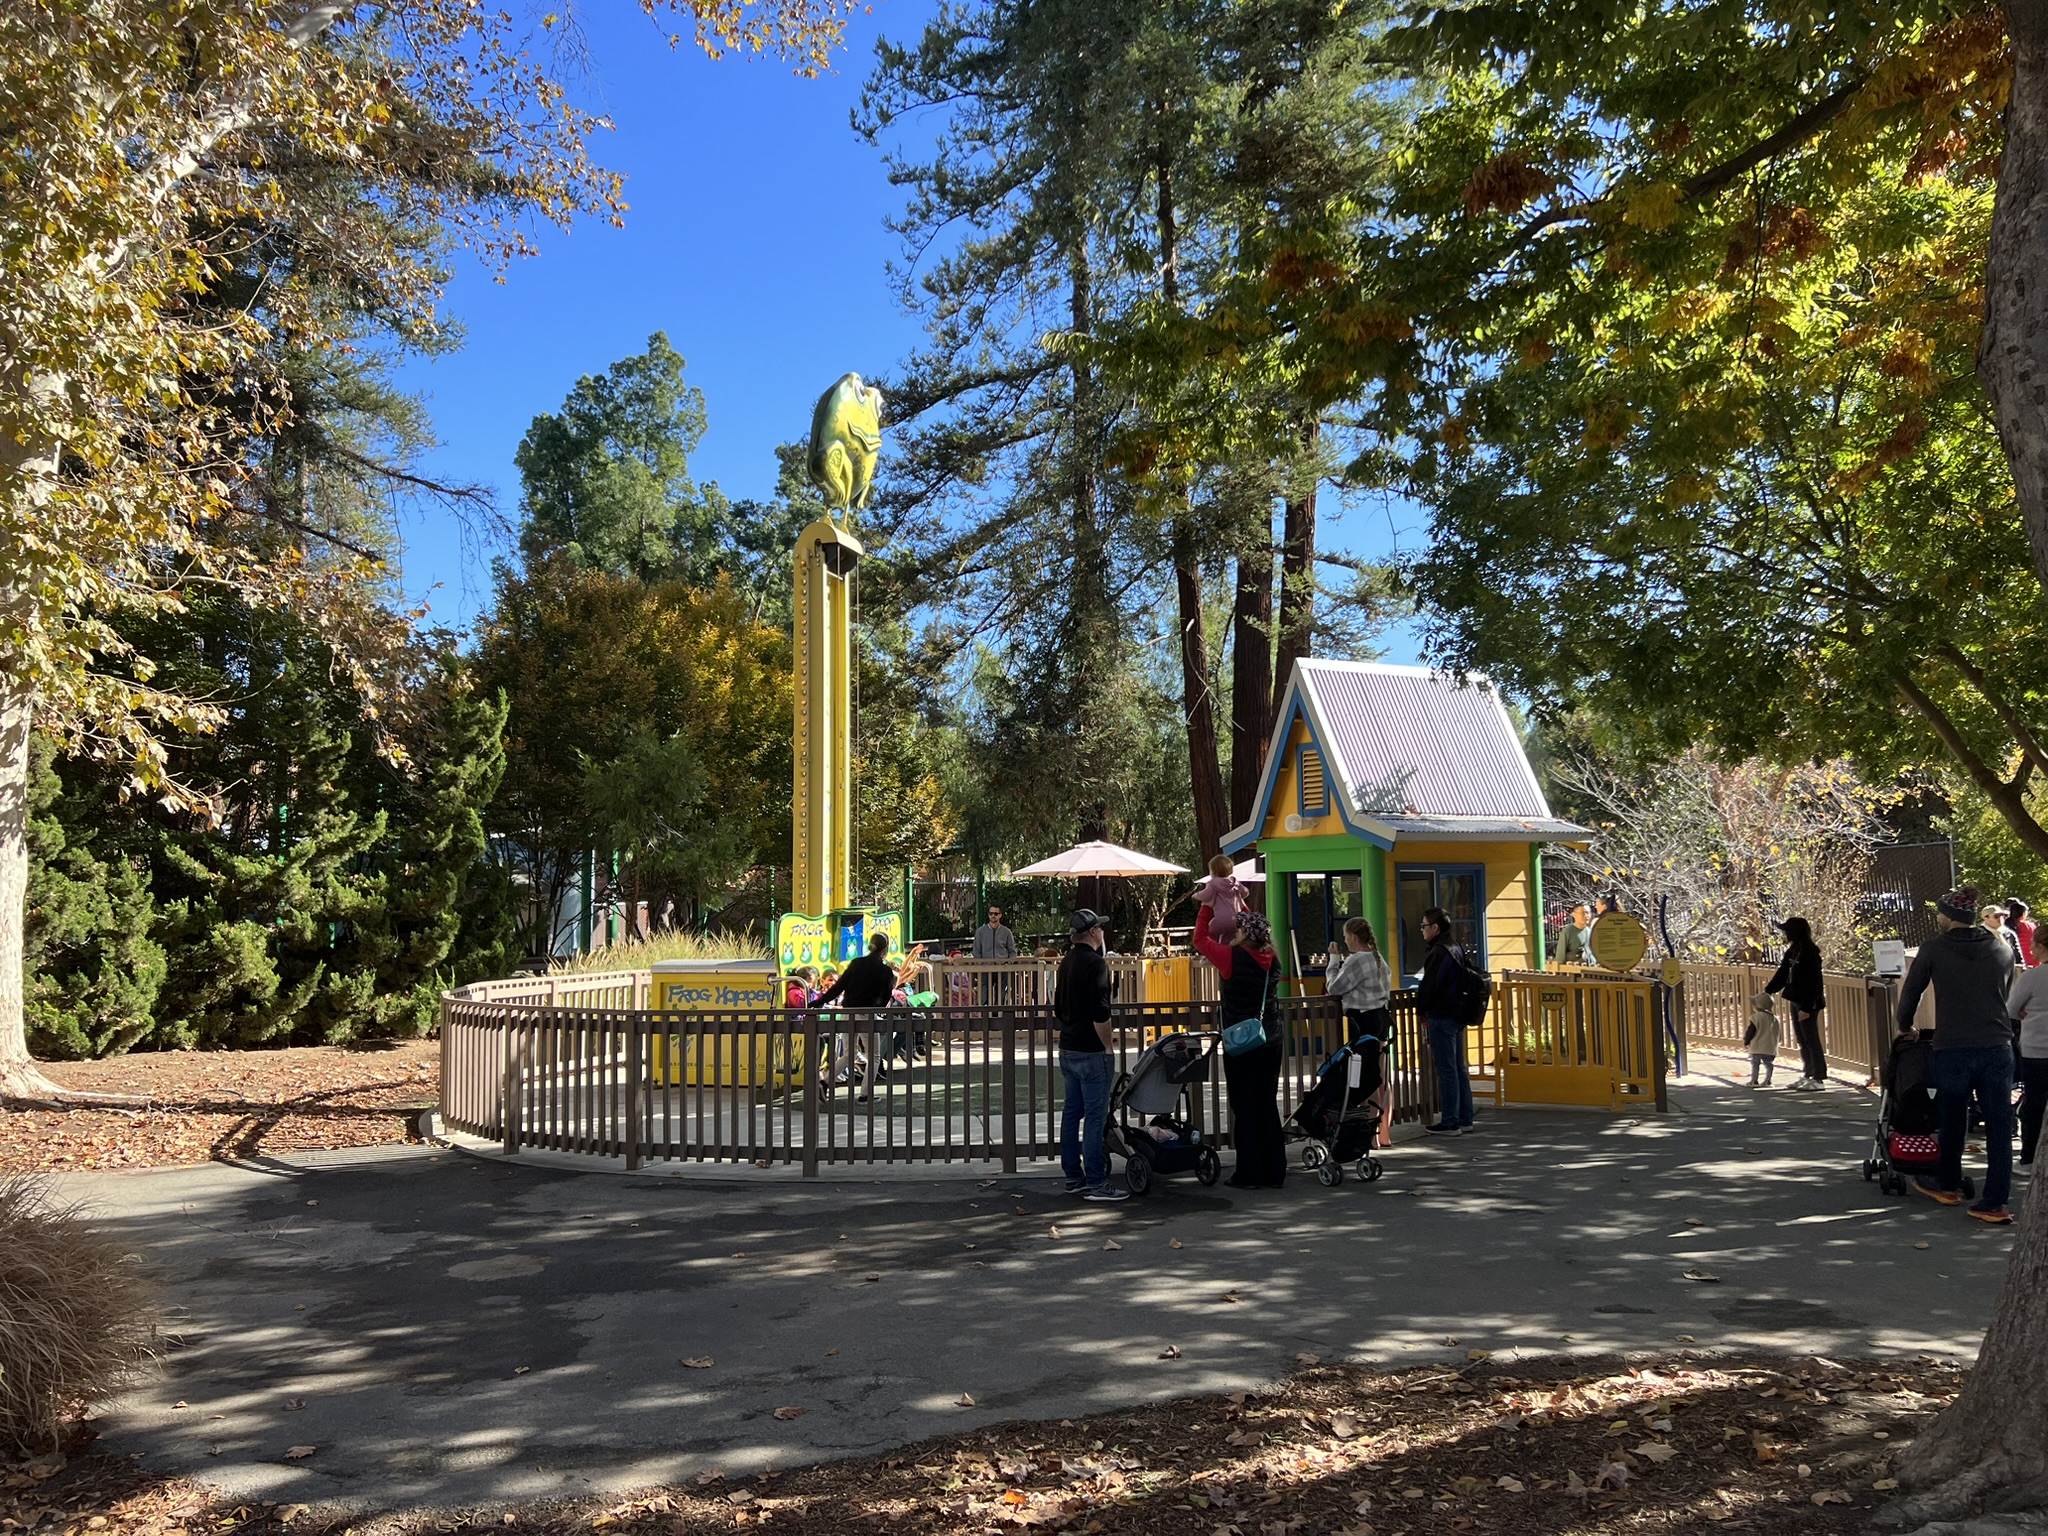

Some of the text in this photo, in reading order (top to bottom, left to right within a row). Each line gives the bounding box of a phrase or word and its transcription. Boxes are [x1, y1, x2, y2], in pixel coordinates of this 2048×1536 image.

[790, 923, 824, 937] FROG
[668, 984, 772, 1007] FROG Hopper
[1541, 992, 1565, 1002] EXIT
